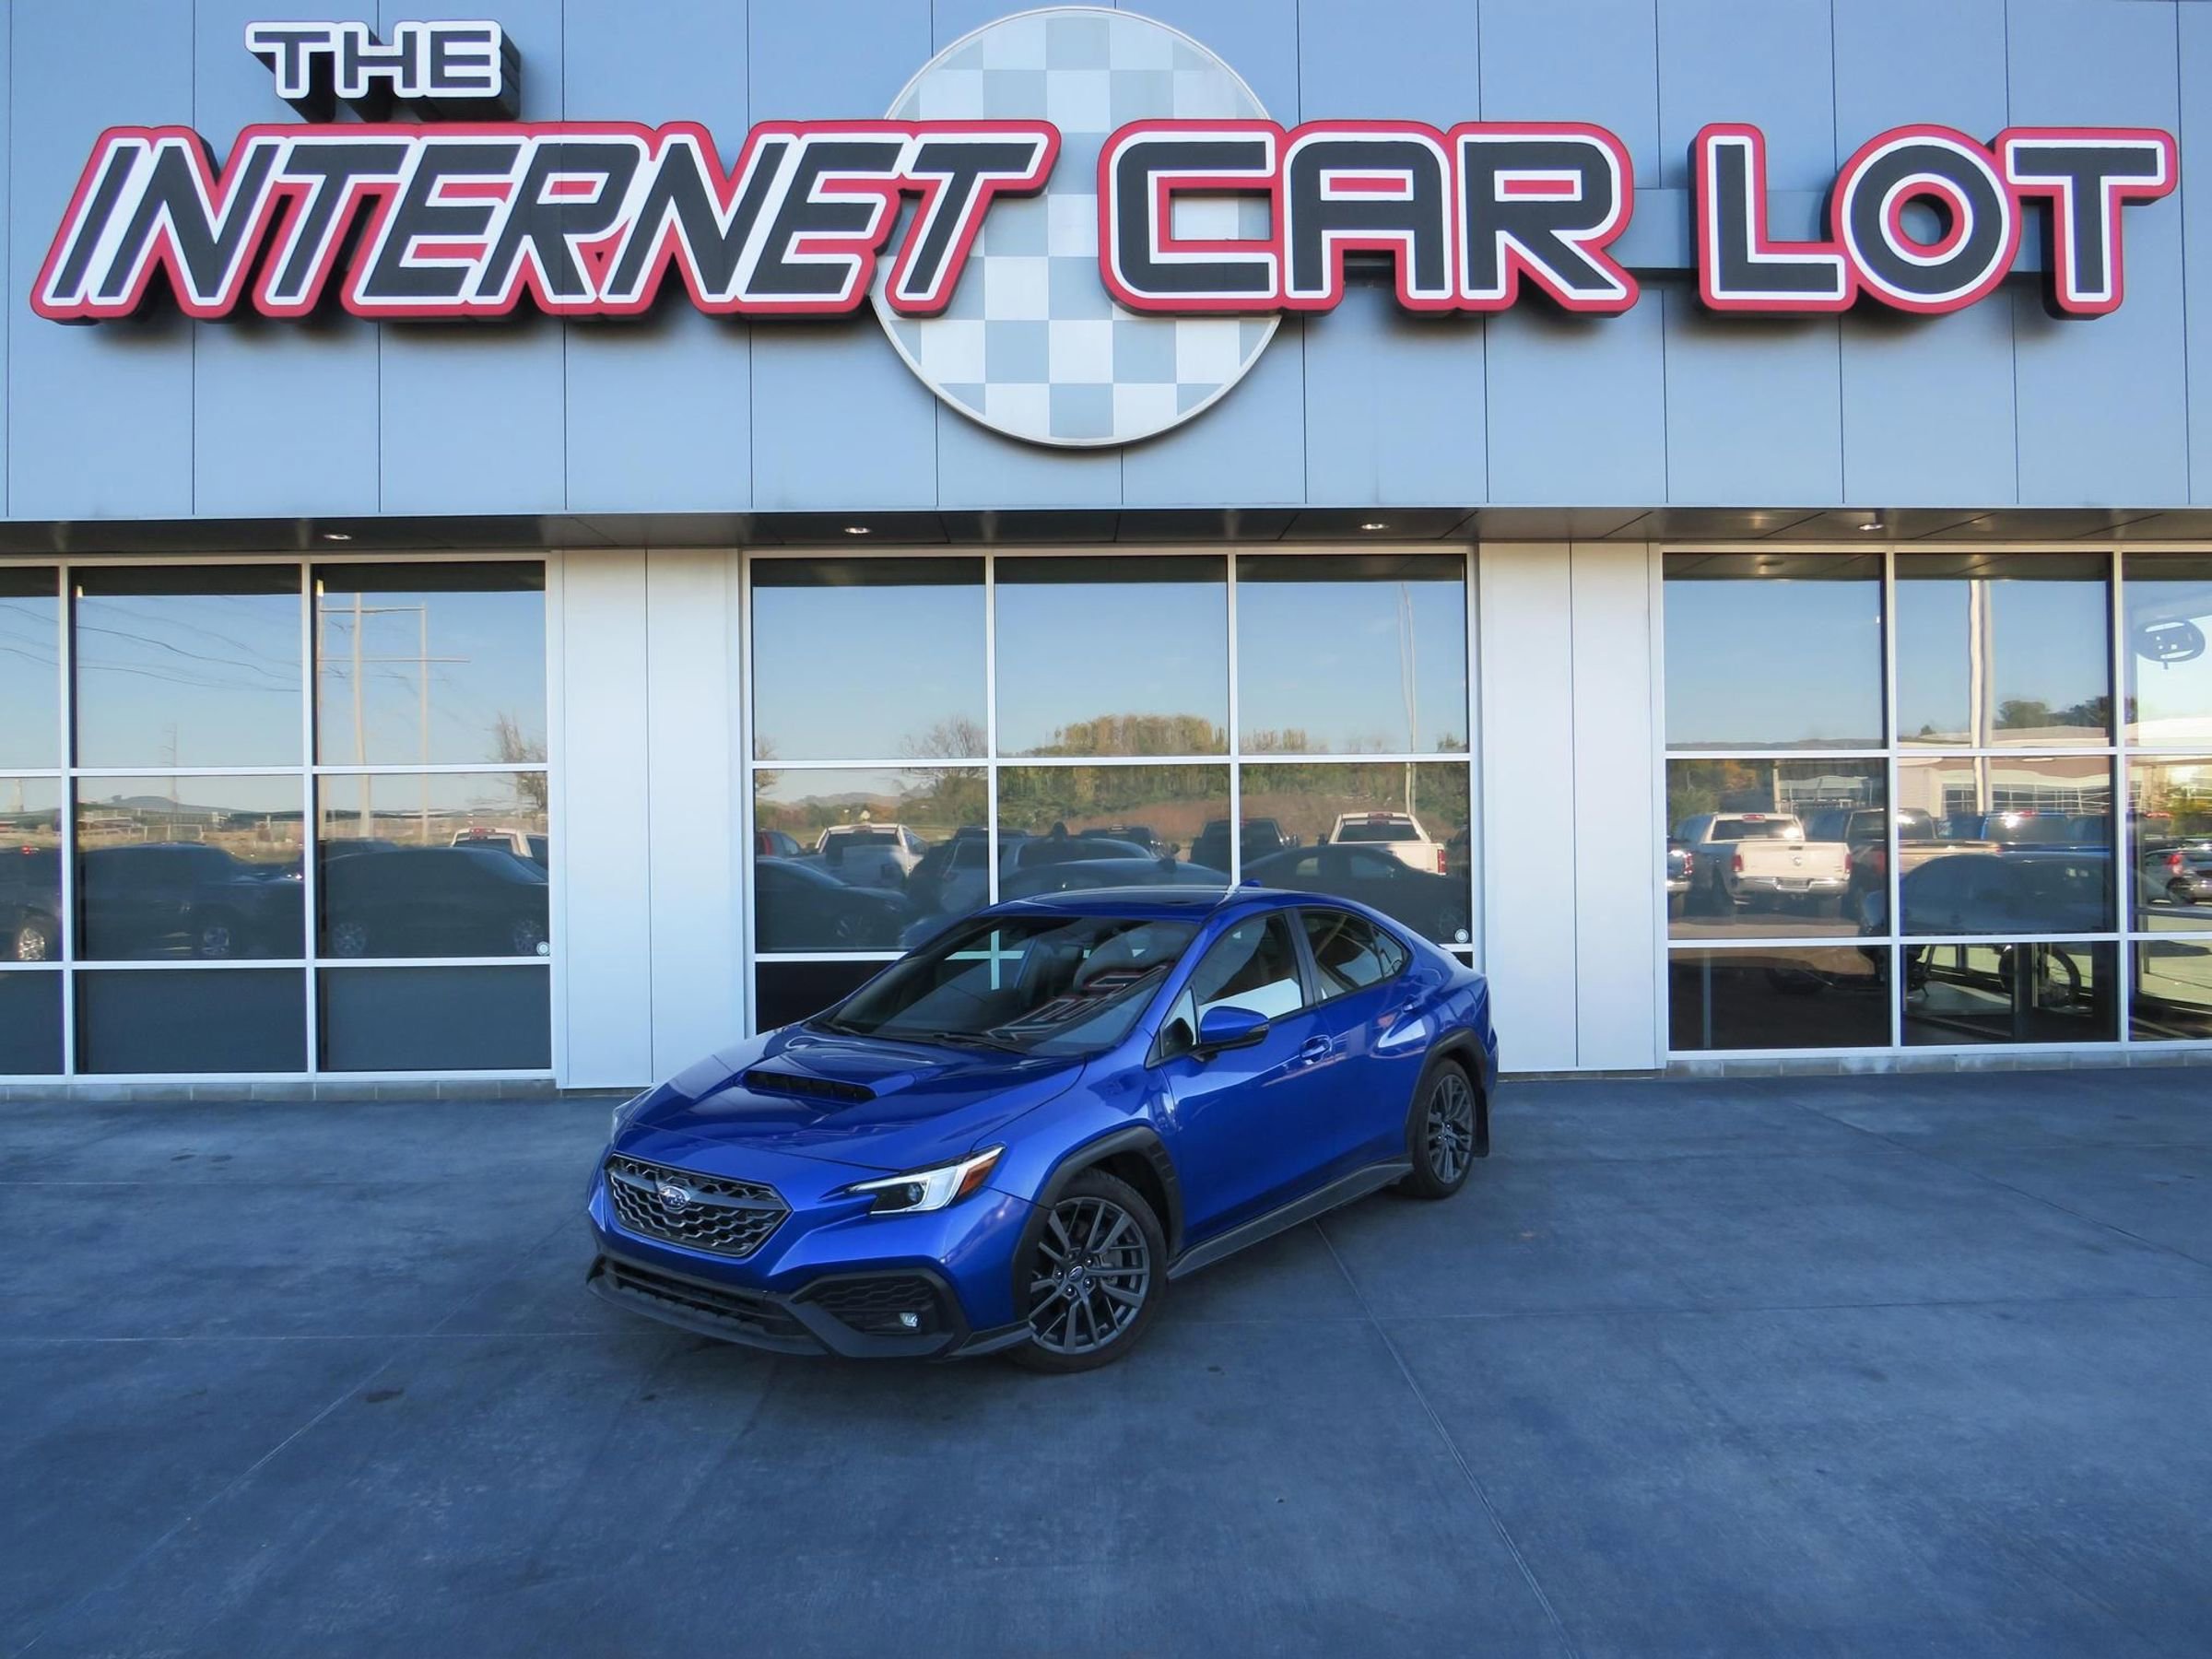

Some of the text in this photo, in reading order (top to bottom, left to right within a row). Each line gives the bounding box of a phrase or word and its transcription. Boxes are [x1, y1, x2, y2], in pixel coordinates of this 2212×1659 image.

[244, 21, 501, 98] THE
[37, 125, 2171, 312] INTERNET CAR LOT
